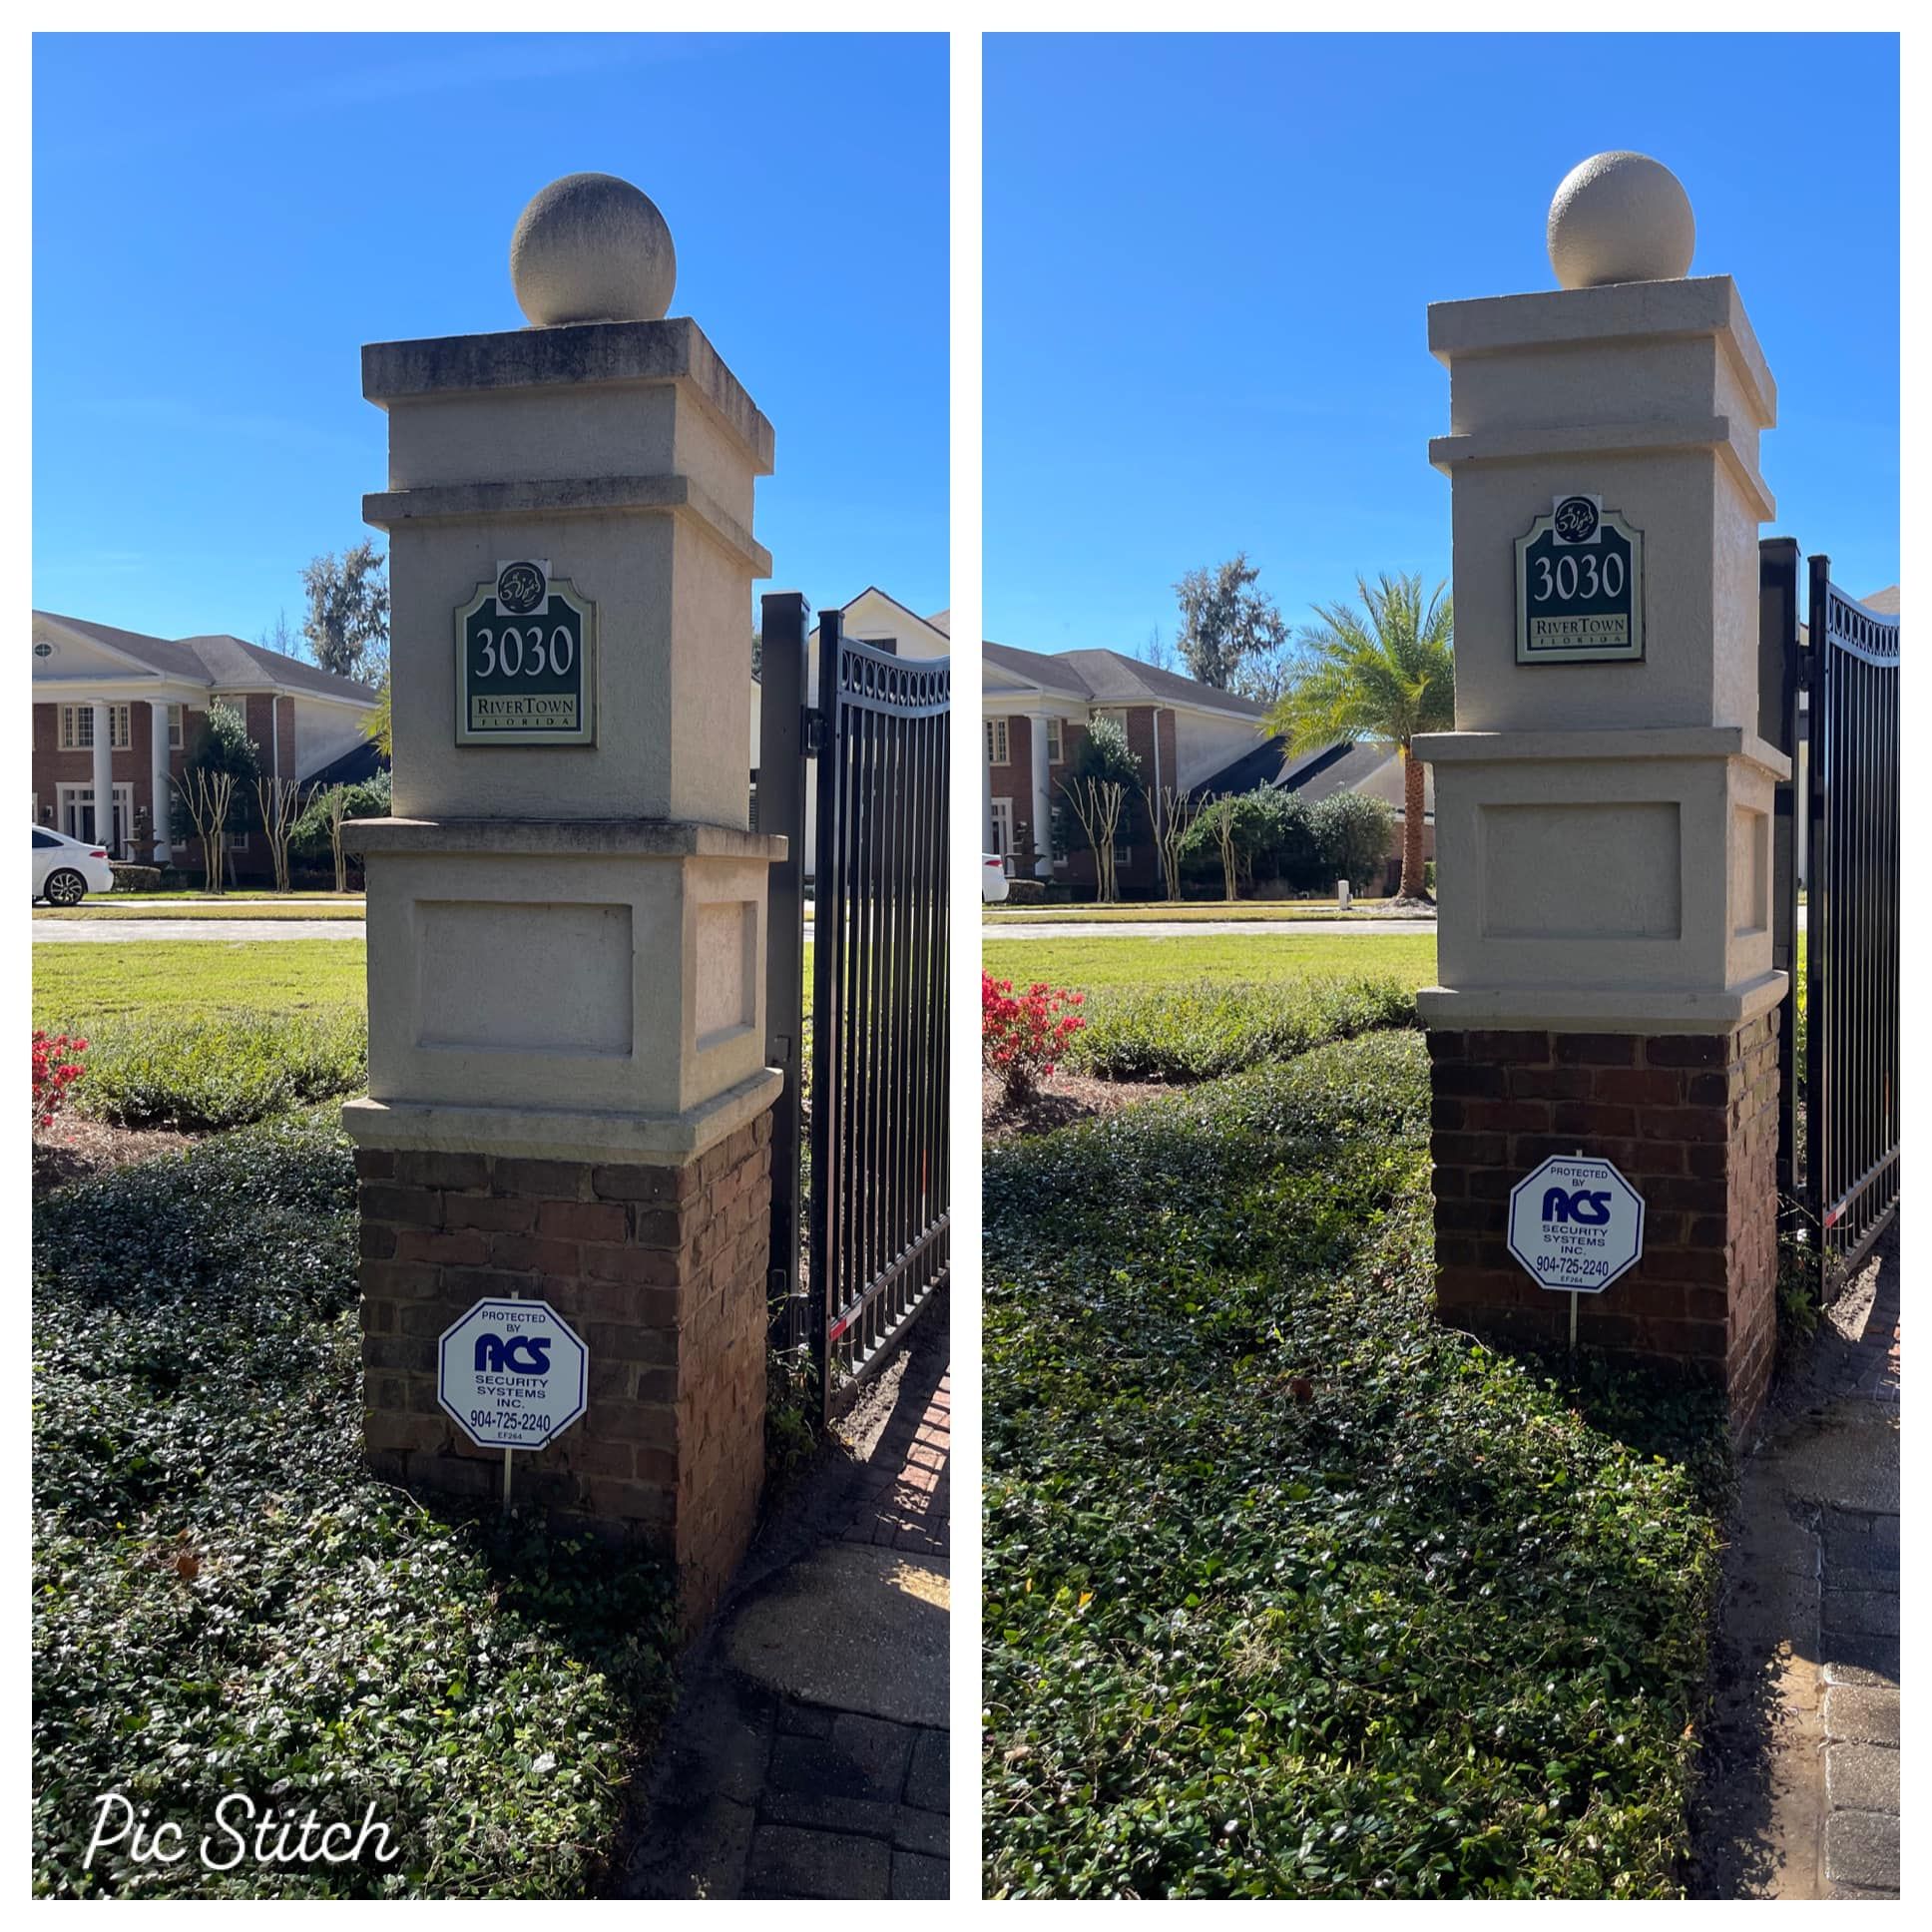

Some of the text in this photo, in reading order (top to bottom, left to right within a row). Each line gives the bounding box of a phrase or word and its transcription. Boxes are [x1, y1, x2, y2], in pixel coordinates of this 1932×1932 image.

[1534, 552, 1624, 601] 3030
[1540, 636, 1622, 645] FLORIDA
[475, 625, 574, 677] 3030
[481, 718, 570, 726] FLORIDA
[1551, 1167, 1608, 1179] PROTECTED
[1542, 1187, 1612, 1225] ACS
[1542, 1224, 1608, 1236] SECURITY
[1544, 1234, 1605, 1246] SYSTEMS
[1561, 1245, 1587, 1255] INC.
[1537, 1255, 1609, 1276] 904-725-2240
[482, 1310, 546, 1323] PROTECTED
[506, 1324, 521, 1333] BY
[474, 1333, 551, 1375] ACS
[475, 1375, 549, 1388] SECURITY
[477, 1386, 546, 1398] SYSTEMS
[497, 1399, 525, 1409] INC.
[470, 1410, 550, 1432] 904-725-2240
